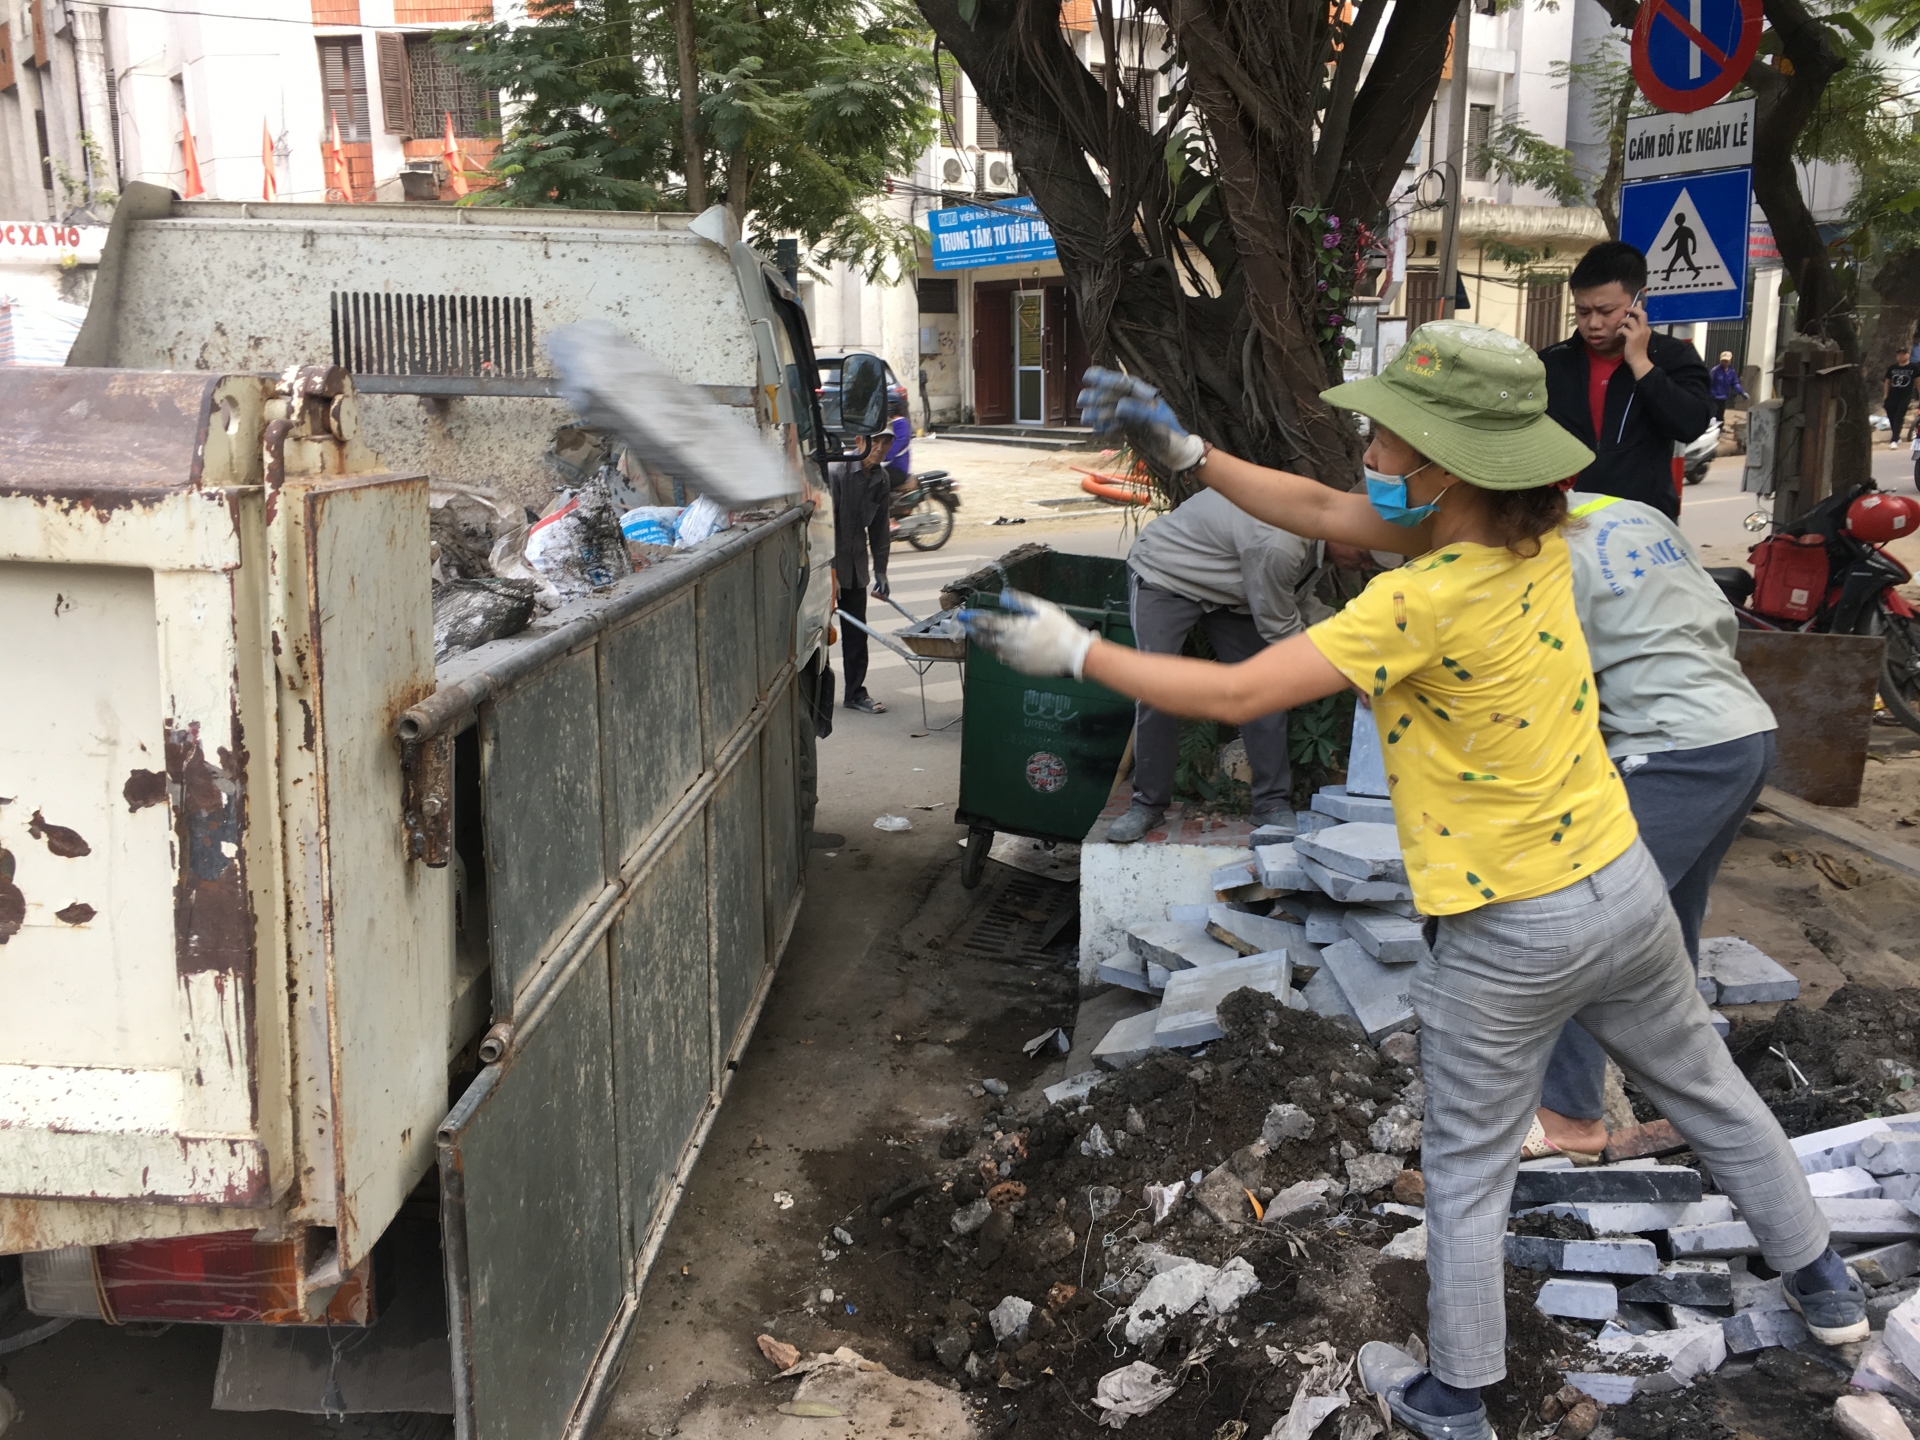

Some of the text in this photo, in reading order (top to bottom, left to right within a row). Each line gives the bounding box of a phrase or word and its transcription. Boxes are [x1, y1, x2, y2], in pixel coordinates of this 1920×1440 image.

[1628, 112, 1749, 162] CẤM ĐỖ XE NGÀY LẺ
[18, 224, 48, 247] XA
[52, 226, 81, 248] HO
[938, 230, 970, 253] TRUNG
[970, 224, 993, 249] TÂM
[993, 225, 1007, 246] TƯ
[1007, 216, 1030, 245] VẤN
[1601, 567, 1615, 580] CP
[1023, 718, 1067, 733] URENCO
